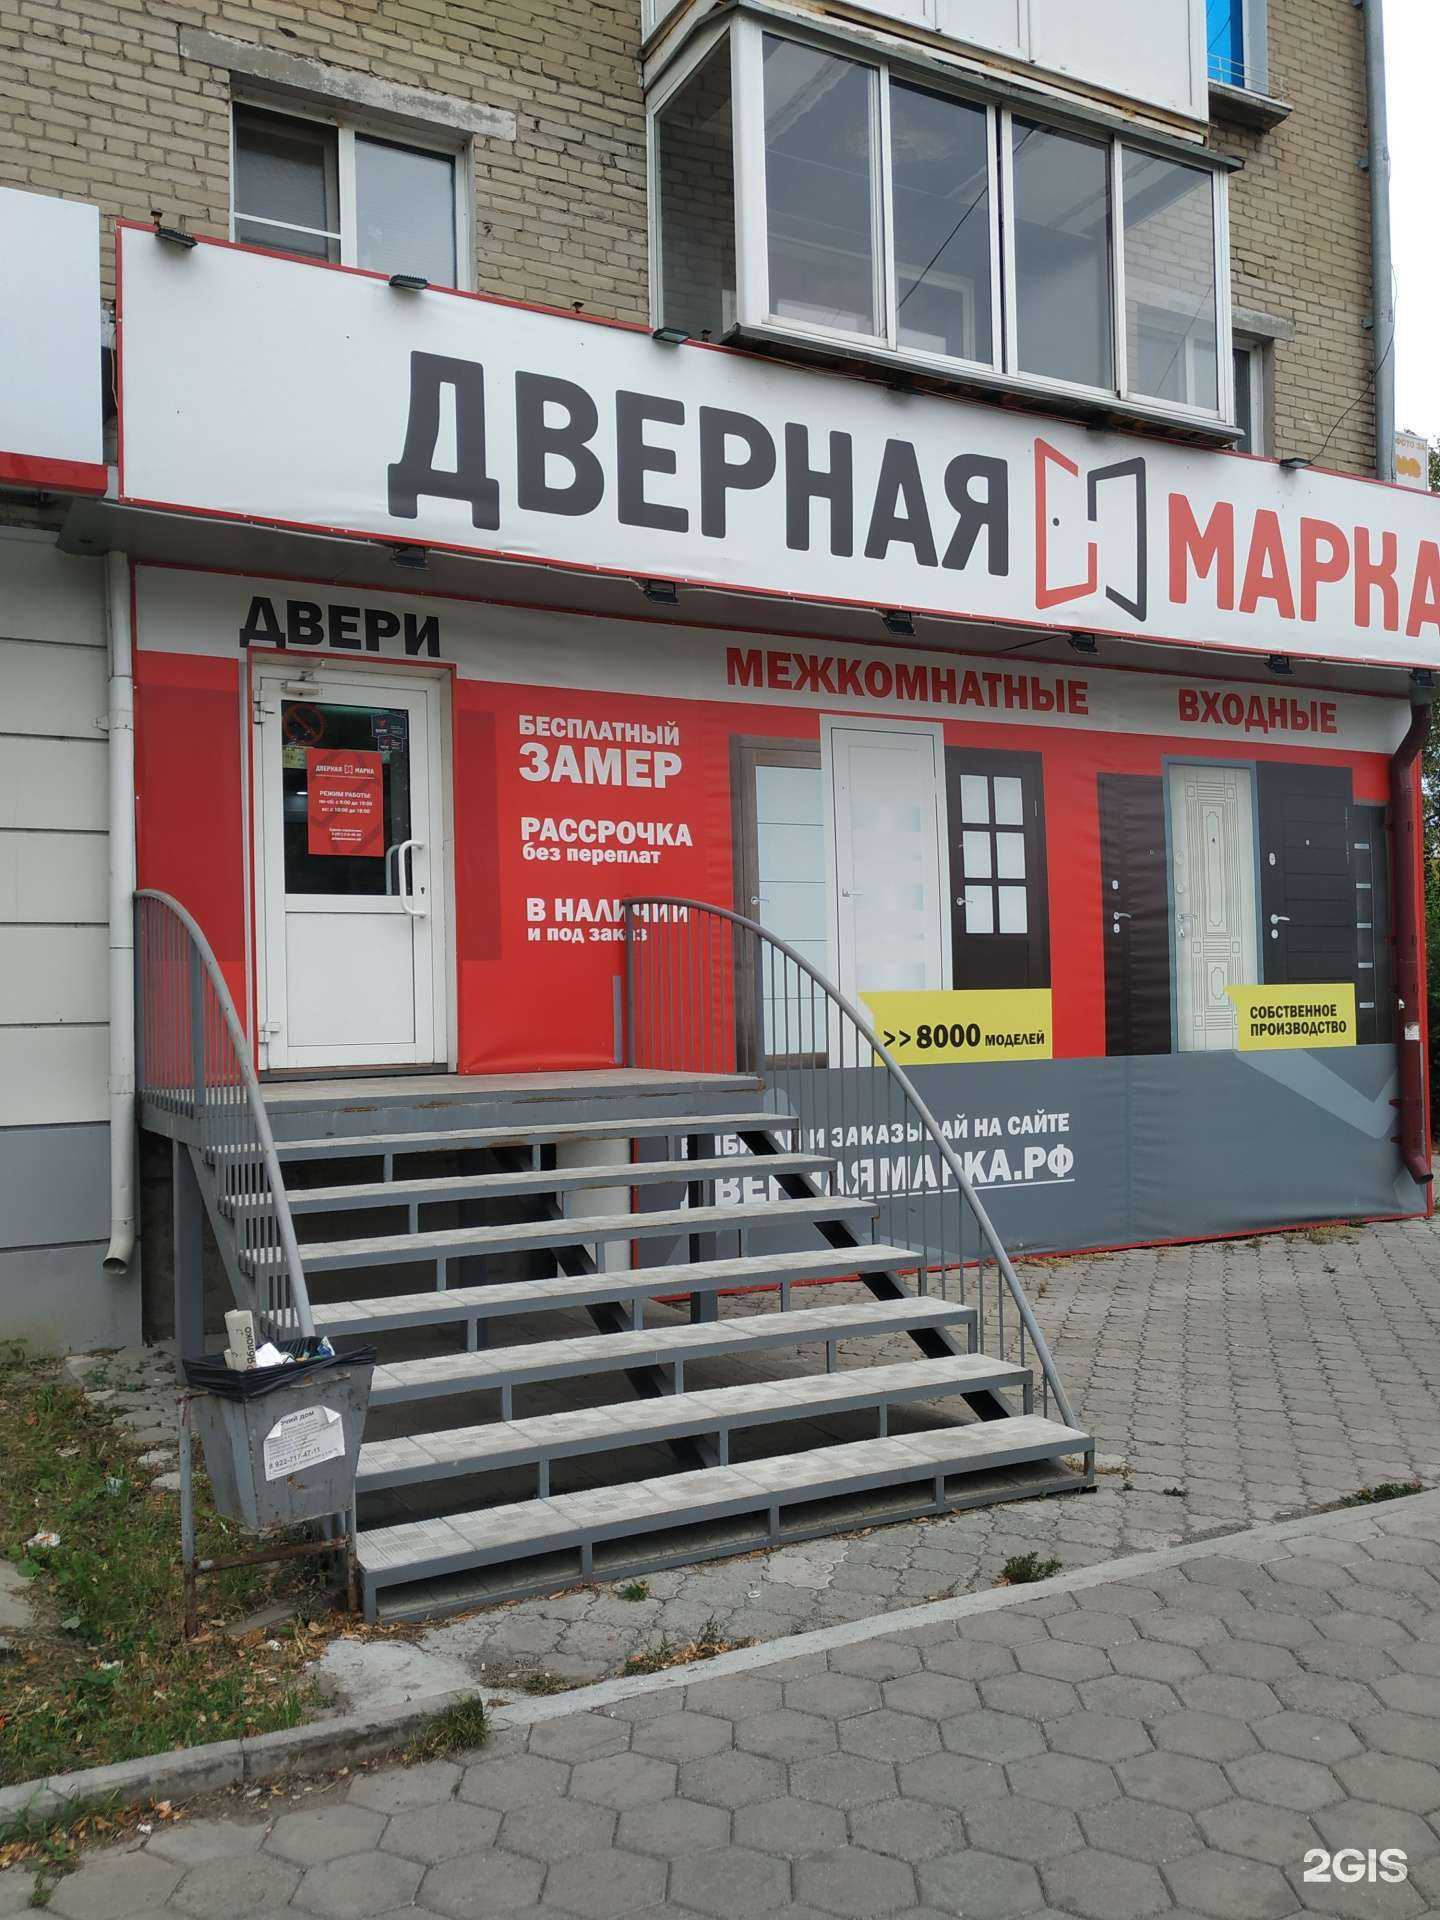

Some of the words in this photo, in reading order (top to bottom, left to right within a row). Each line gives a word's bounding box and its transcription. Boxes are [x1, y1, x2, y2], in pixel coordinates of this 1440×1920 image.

[387, 350, 1009, 577] ДВЕРНАЯ
[1168, 491, 1440, 638] МАРКА
[239, 596, 441, 658] ДВЕРИ
[726, 647, 1089, 715] МЕЖКОМНАТНЫЕ
[1178, 688, 1338, 734] ВХОДНЫЕ
[518, 714, 680, 746] БЕСПЛАТНЫЙ
[518, 742, 682, 789] ЗАМЕР
[521, 816, 693, 847] РАССРОЧКА
[522, 842, 561, 862] без
[567, 848, 661, 866] переплат
[526, 898, 546, 923] В
[527, 927, 541, 942] и
[547, 927, 584, 944] под
[589, 927, 648, 942] закз
[1250, 1004, 1337, 1020] СОБСТВЕННОЕ
[916, 1023, 981, 1049] 8000
[985, 1030, 1045, 1048] МОДЕЛЕЙ
[1250, 1020, 1347, 1037] ПРОИЗВОДСТВО
[809, 1128, 825, 1149] И
[974, 1117, 1002, 1138] НА
[1007, 1108, 1070, 1136] САЙТЕ
